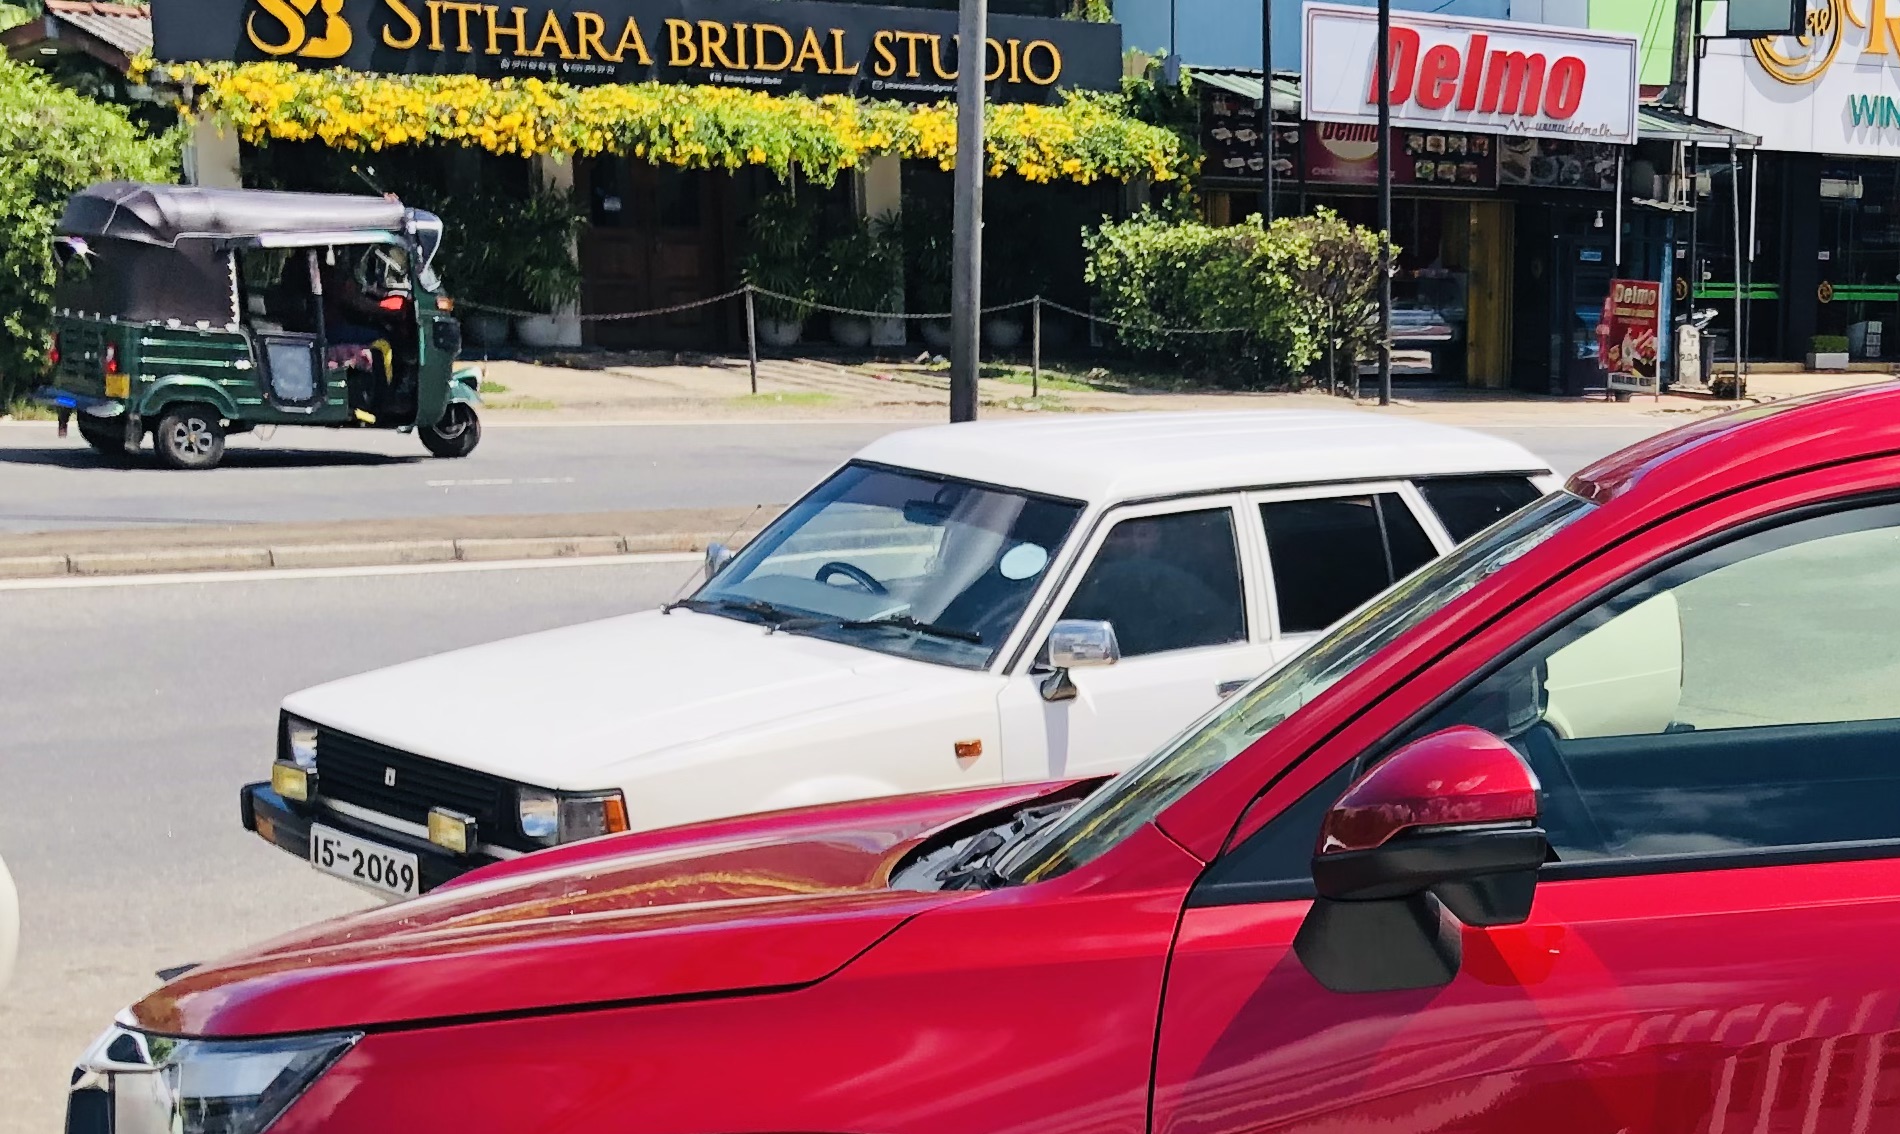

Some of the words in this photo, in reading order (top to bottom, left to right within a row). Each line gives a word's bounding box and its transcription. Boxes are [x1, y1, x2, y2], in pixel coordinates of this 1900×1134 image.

[383, 0, 654, 65] SITHARA
[665, 18, 860, 76] BRIDAL
[873, 30, 1063, 86] STUDIO
[1367, 26, 1586, 120] Delmo
[1614, 284, 1657, 305] Delmo
[314, 835, 414, 894] 15-2069
